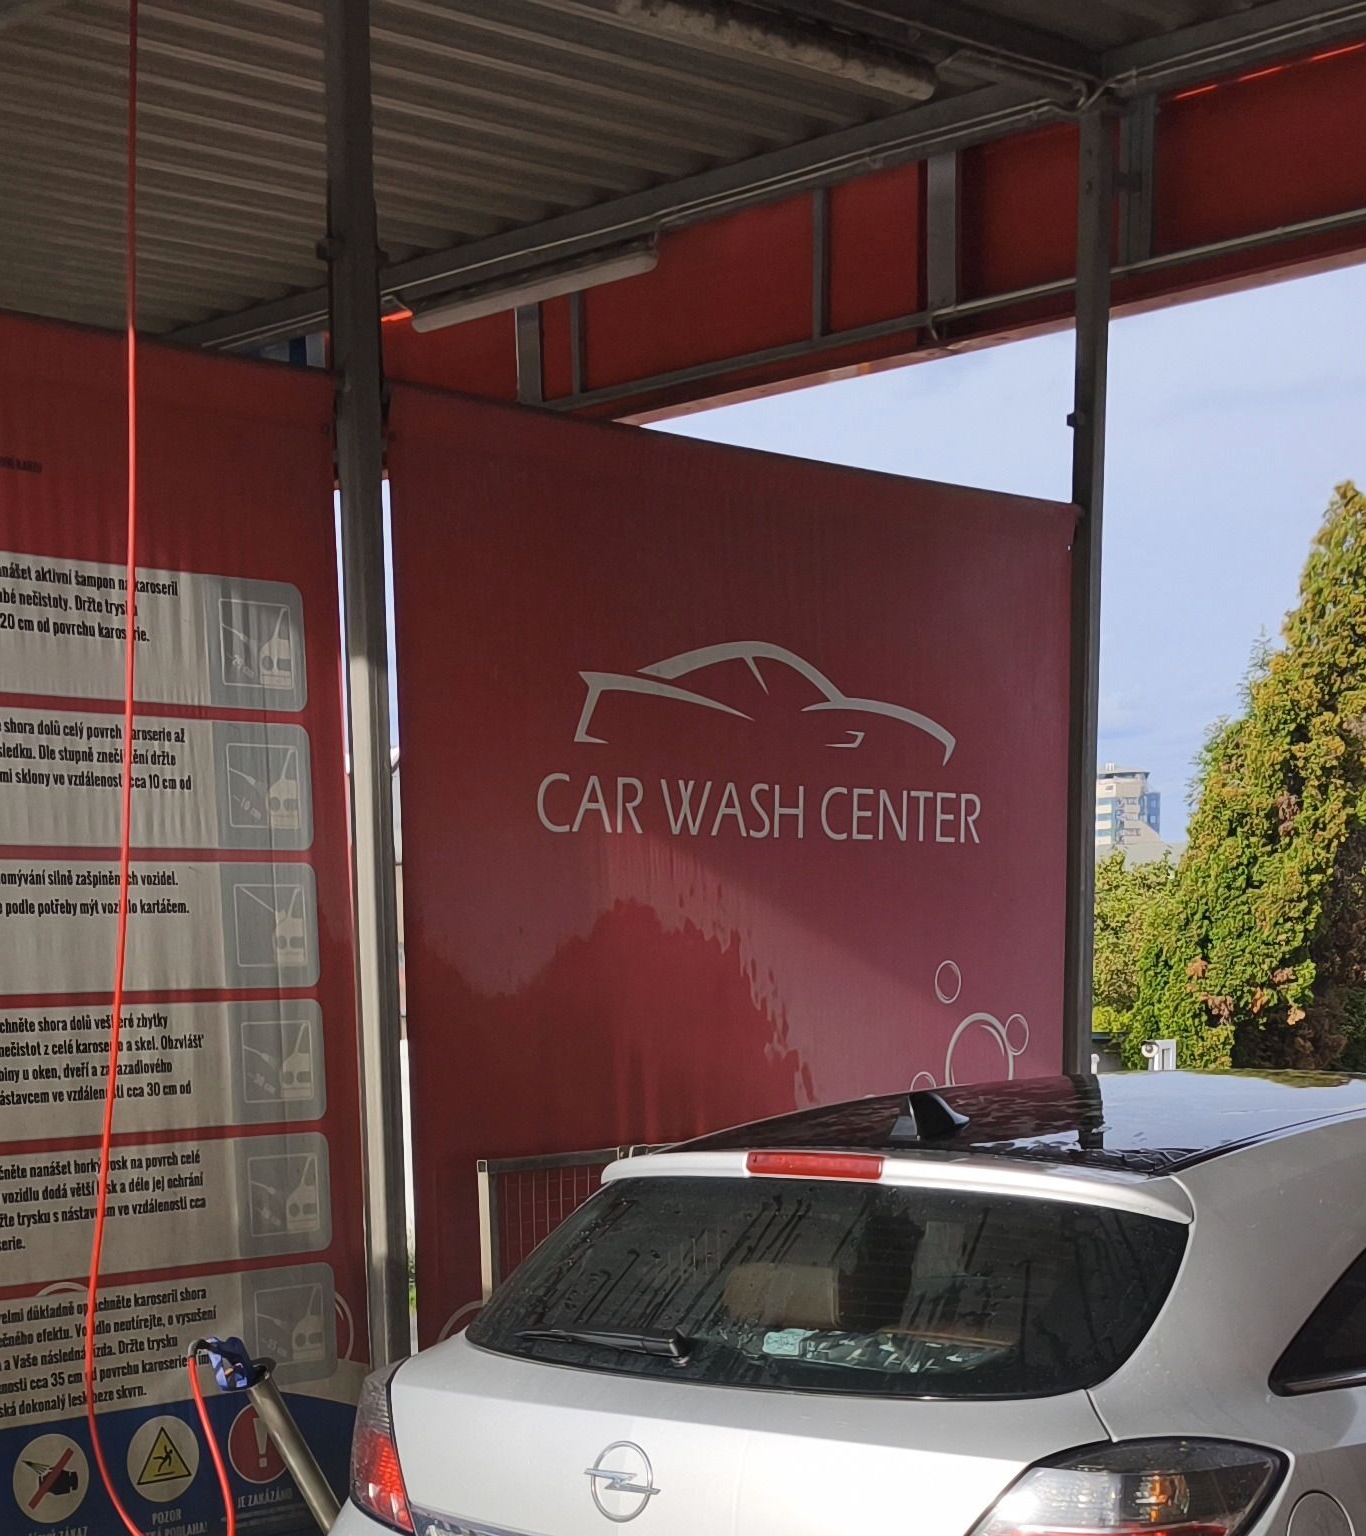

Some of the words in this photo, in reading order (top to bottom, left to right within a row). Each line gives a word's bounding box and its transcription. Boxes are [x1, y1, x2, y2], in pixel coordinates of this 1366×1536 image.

[34, 565, 72, 585] aktivní
[73, 569, 116, 591] šampon
[537, 772, 644, 834] CAR
[660, 778, 805, 840] WASH
[821, 786, 981, 845] CENTER
[47, 868, 73, 886] silně
[74, 864, 138, 888] zašpiněnch
[139, 870, 178, 886] vozidel.
[18, 1392, 66, 1415] dokonalý
[152, 1508, 182, 1526] POZOR
